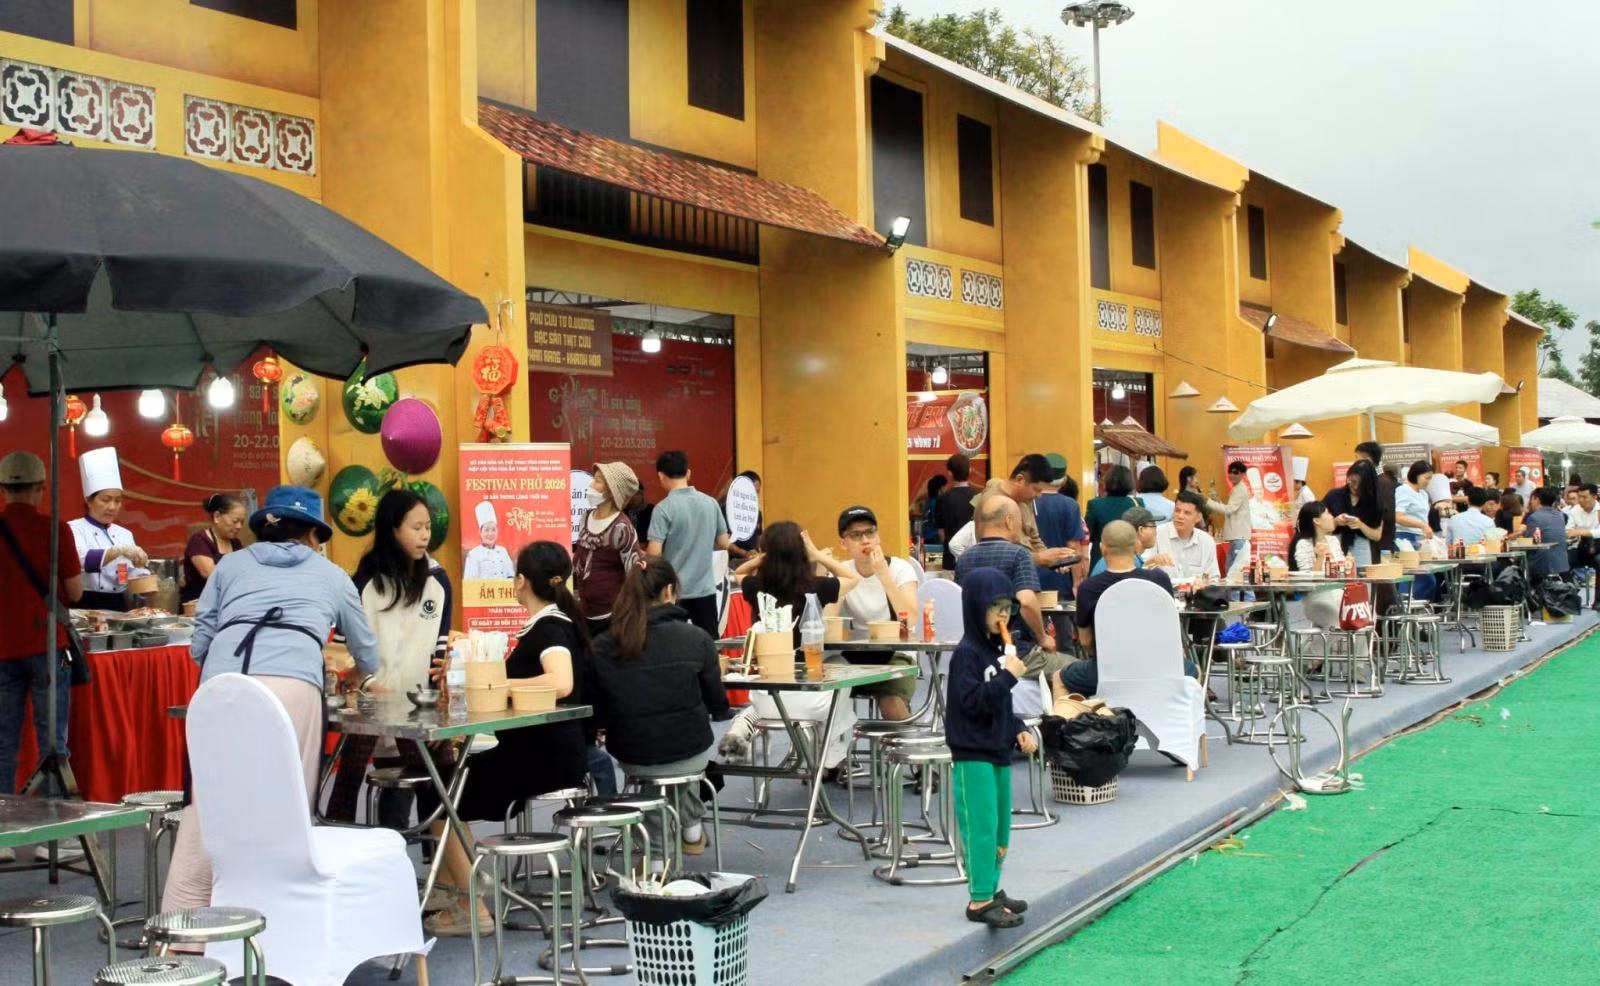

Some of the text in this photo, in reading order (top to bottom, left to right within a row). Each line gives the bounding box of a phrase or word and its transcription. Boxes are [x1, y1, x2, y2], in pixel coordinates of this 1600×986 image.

[465, 473, 567, 491] FESTIVAN PHỞ 2026
[498, 587, 518, 599] TH
